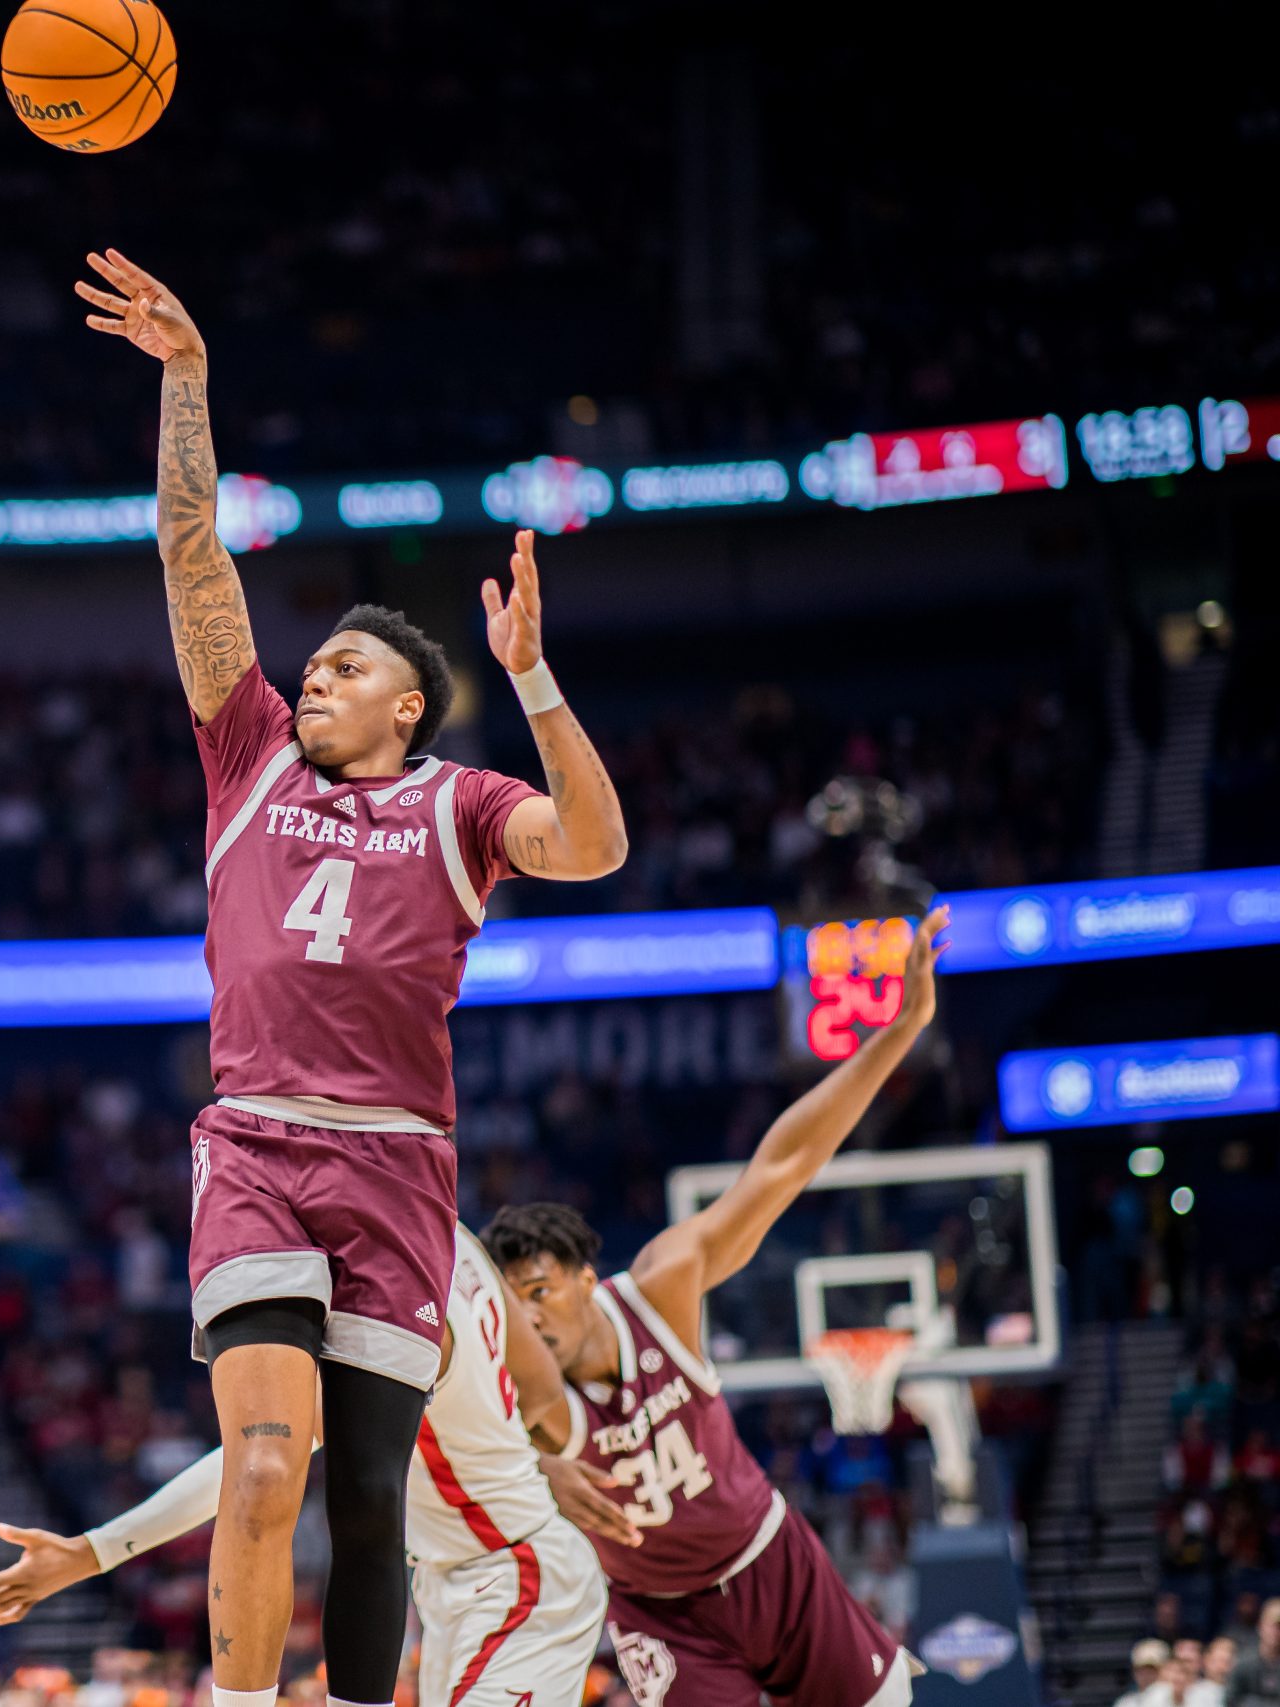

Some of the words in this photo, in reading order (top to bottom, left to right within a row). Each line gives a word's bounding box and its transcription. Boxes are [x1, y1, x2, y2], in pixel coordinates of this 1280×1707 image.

[266, 804, 358, 848] TEXAS
[363, 827, 429, 858] A&M
[400, 791, 422, 805] SEC
[282, 857, 356, 965] 4
[610, 1419, 714, 1529] 34
